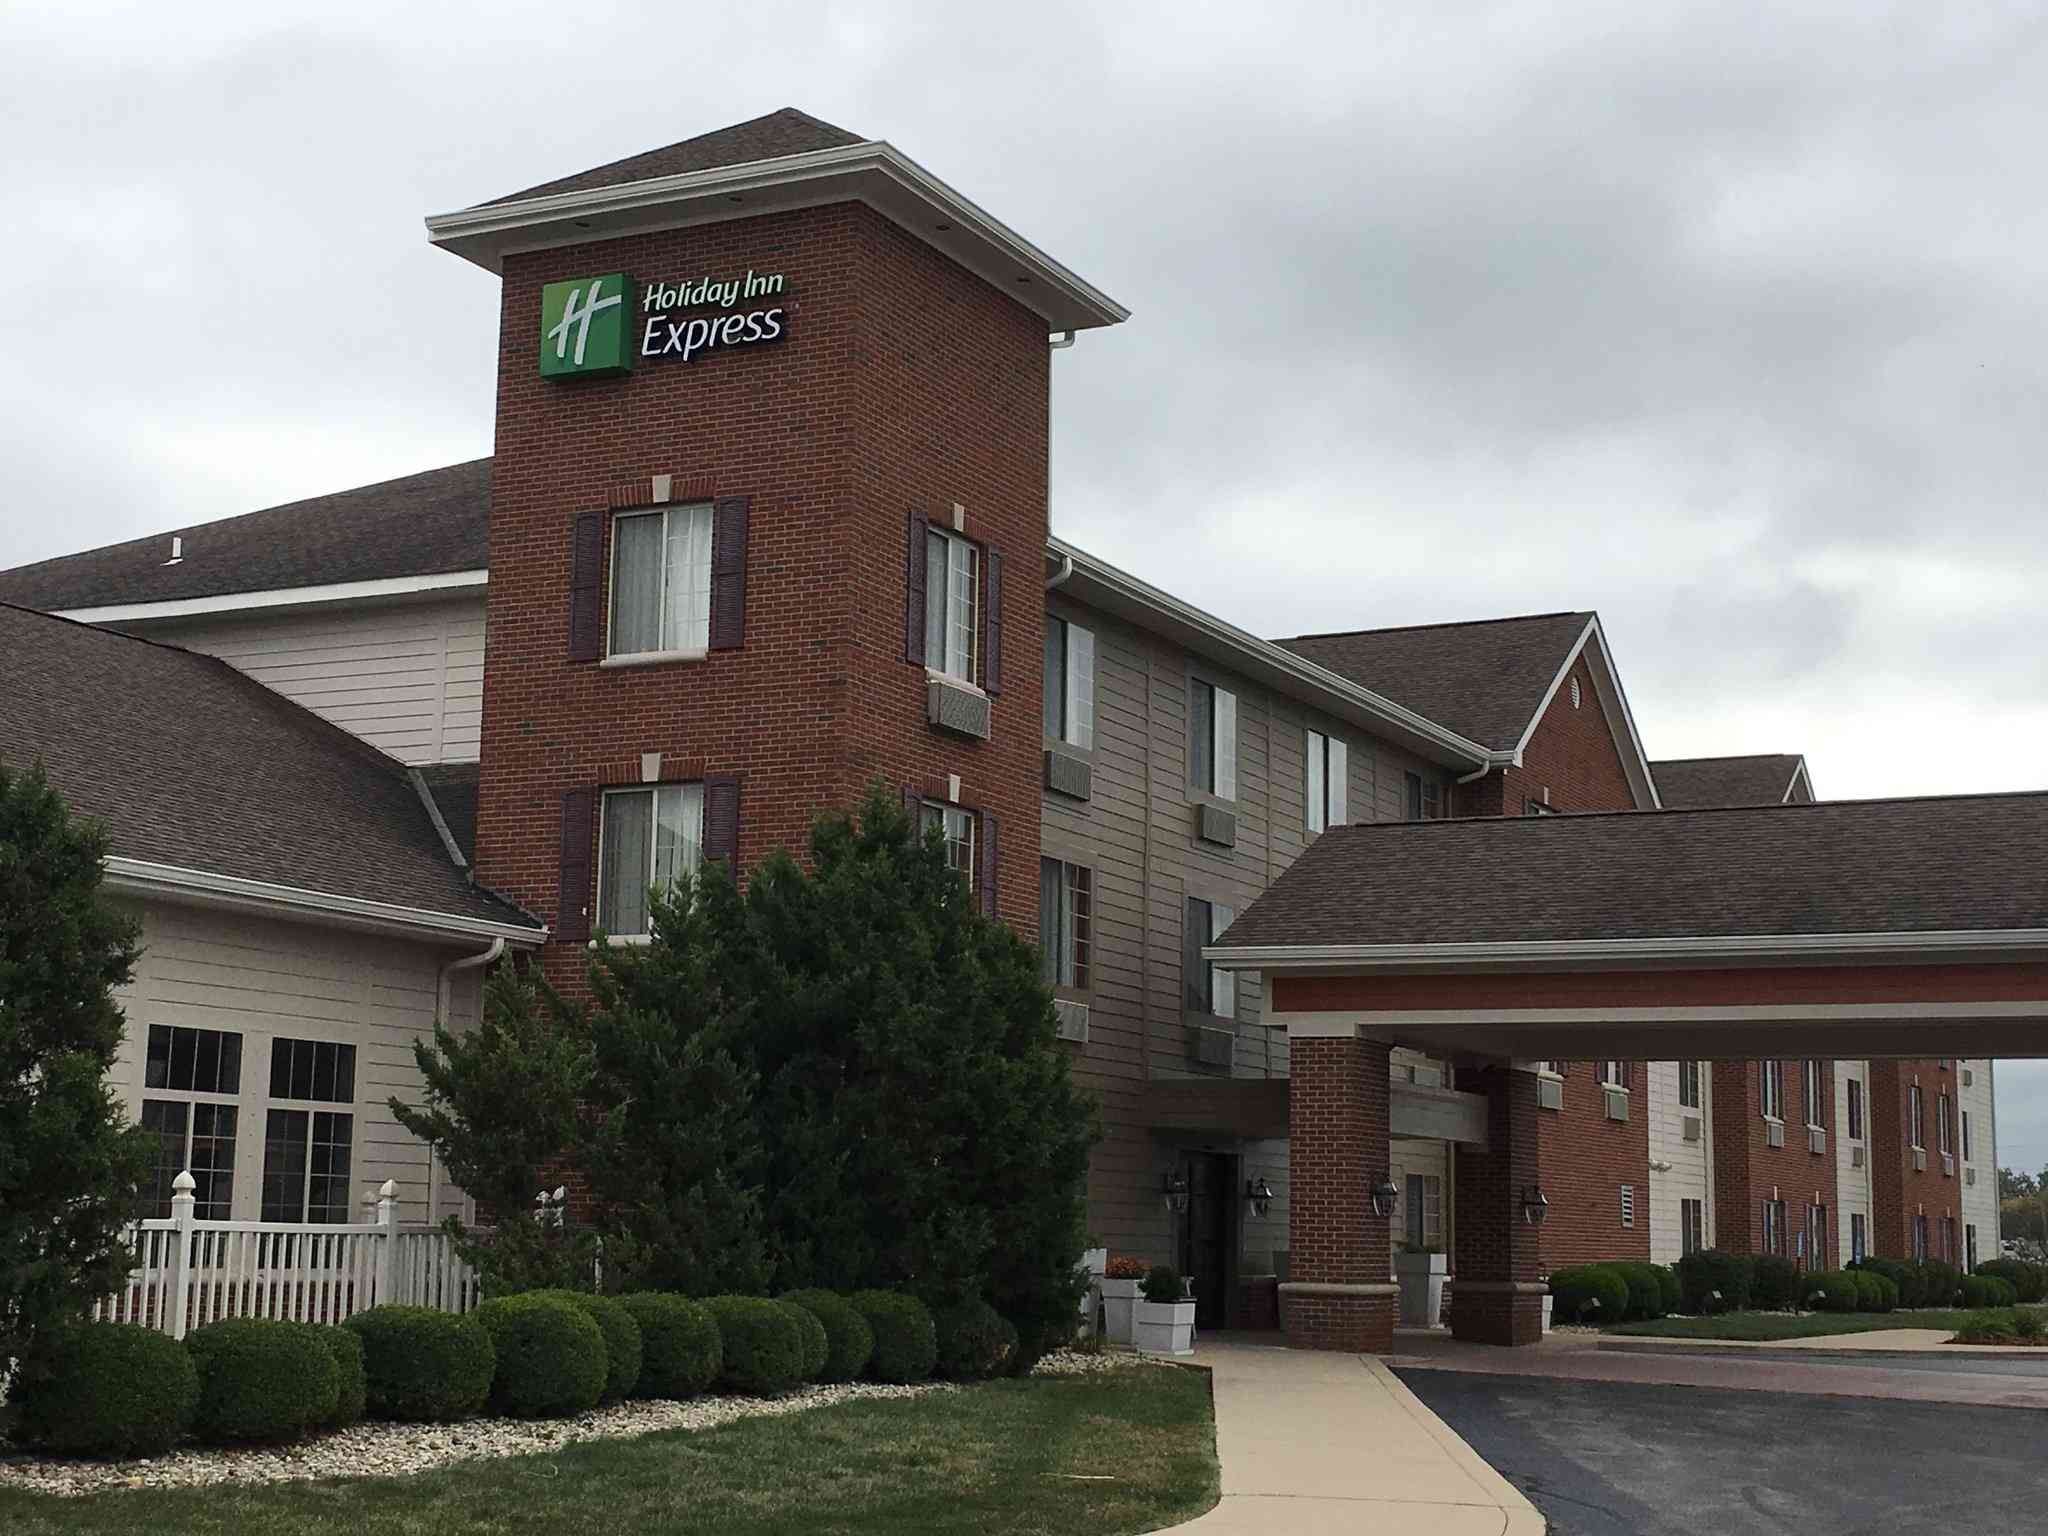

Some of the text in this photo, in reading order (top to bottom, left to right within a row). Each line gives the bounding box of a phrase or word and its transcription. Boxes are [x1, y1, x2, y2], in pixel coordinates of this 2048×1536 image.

[643, 270, 784, 312] Holiday Inn
[548, 280, 621, 365] H
[642, 308, 783, 361] Express
